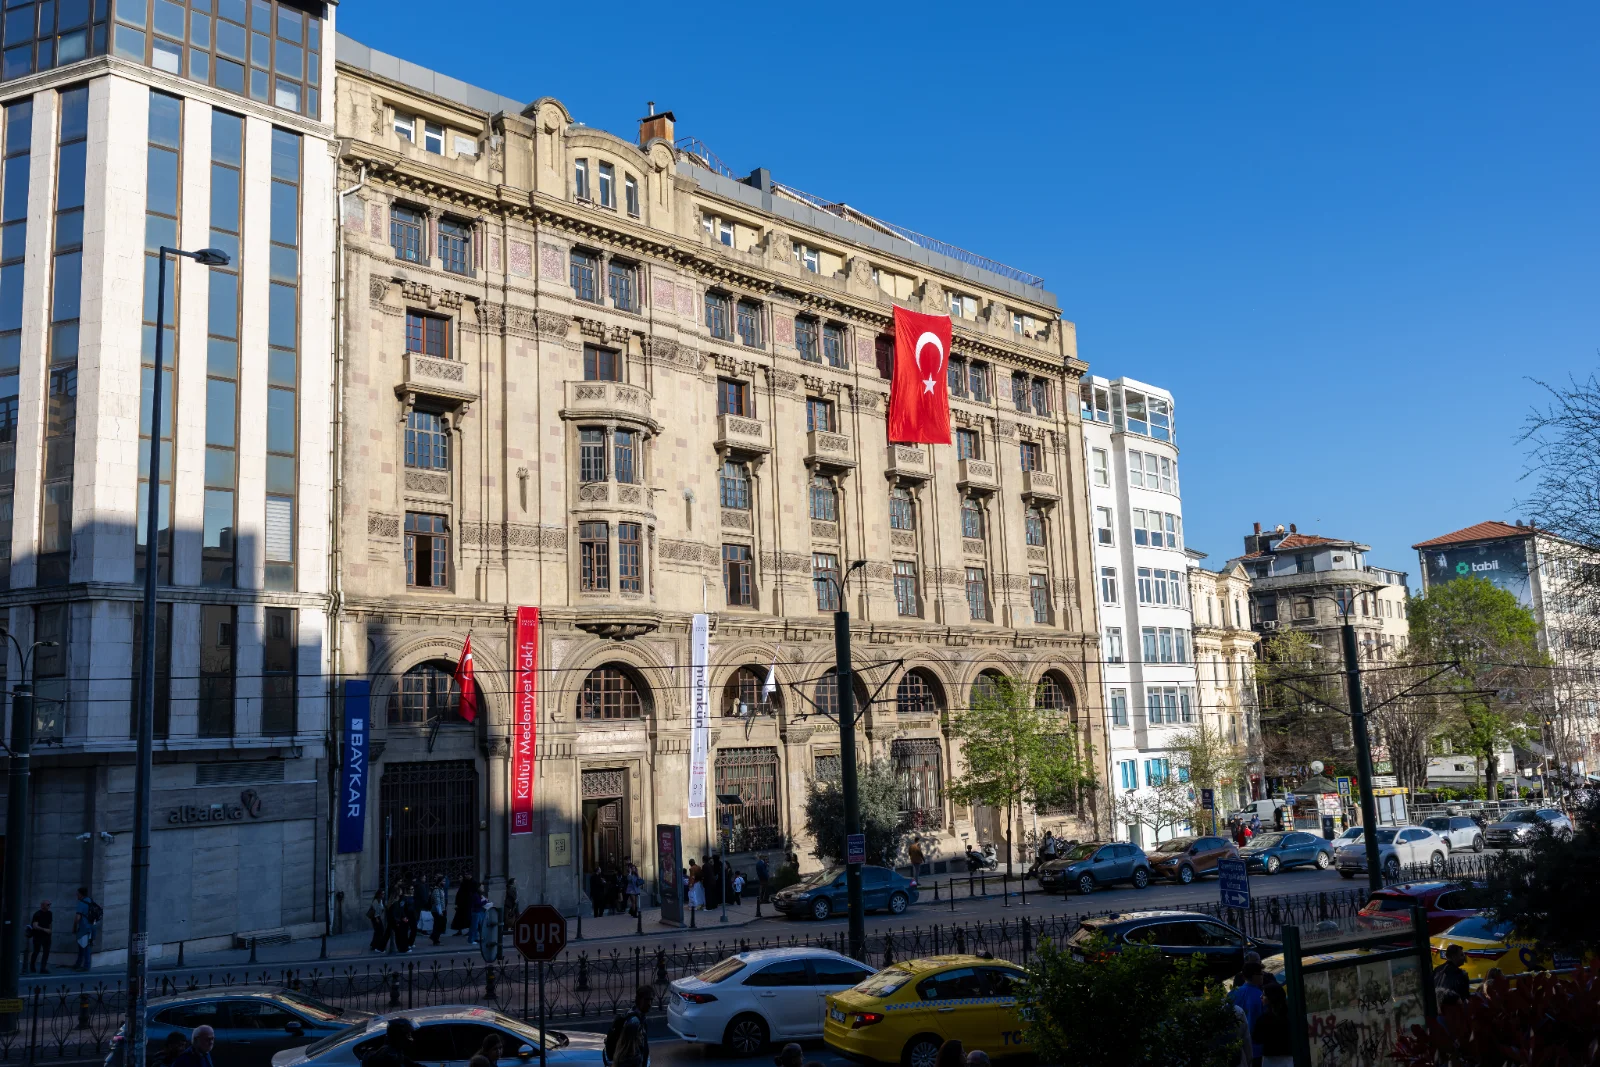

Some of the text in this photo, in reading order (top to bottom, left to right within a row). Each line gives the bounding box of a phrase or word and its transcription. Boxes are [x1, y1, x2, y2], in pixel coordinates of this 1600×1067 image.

[521, 641, 534, 677] Vakfı
[519, 679, 535, 755] Medeniyet
[696, 667, 708, 728] mümkün
[347, 733, 363, 818] BAYKAR
[517, 759, 531, 799] Kültür
[519, 922, 561, 944] DUR
